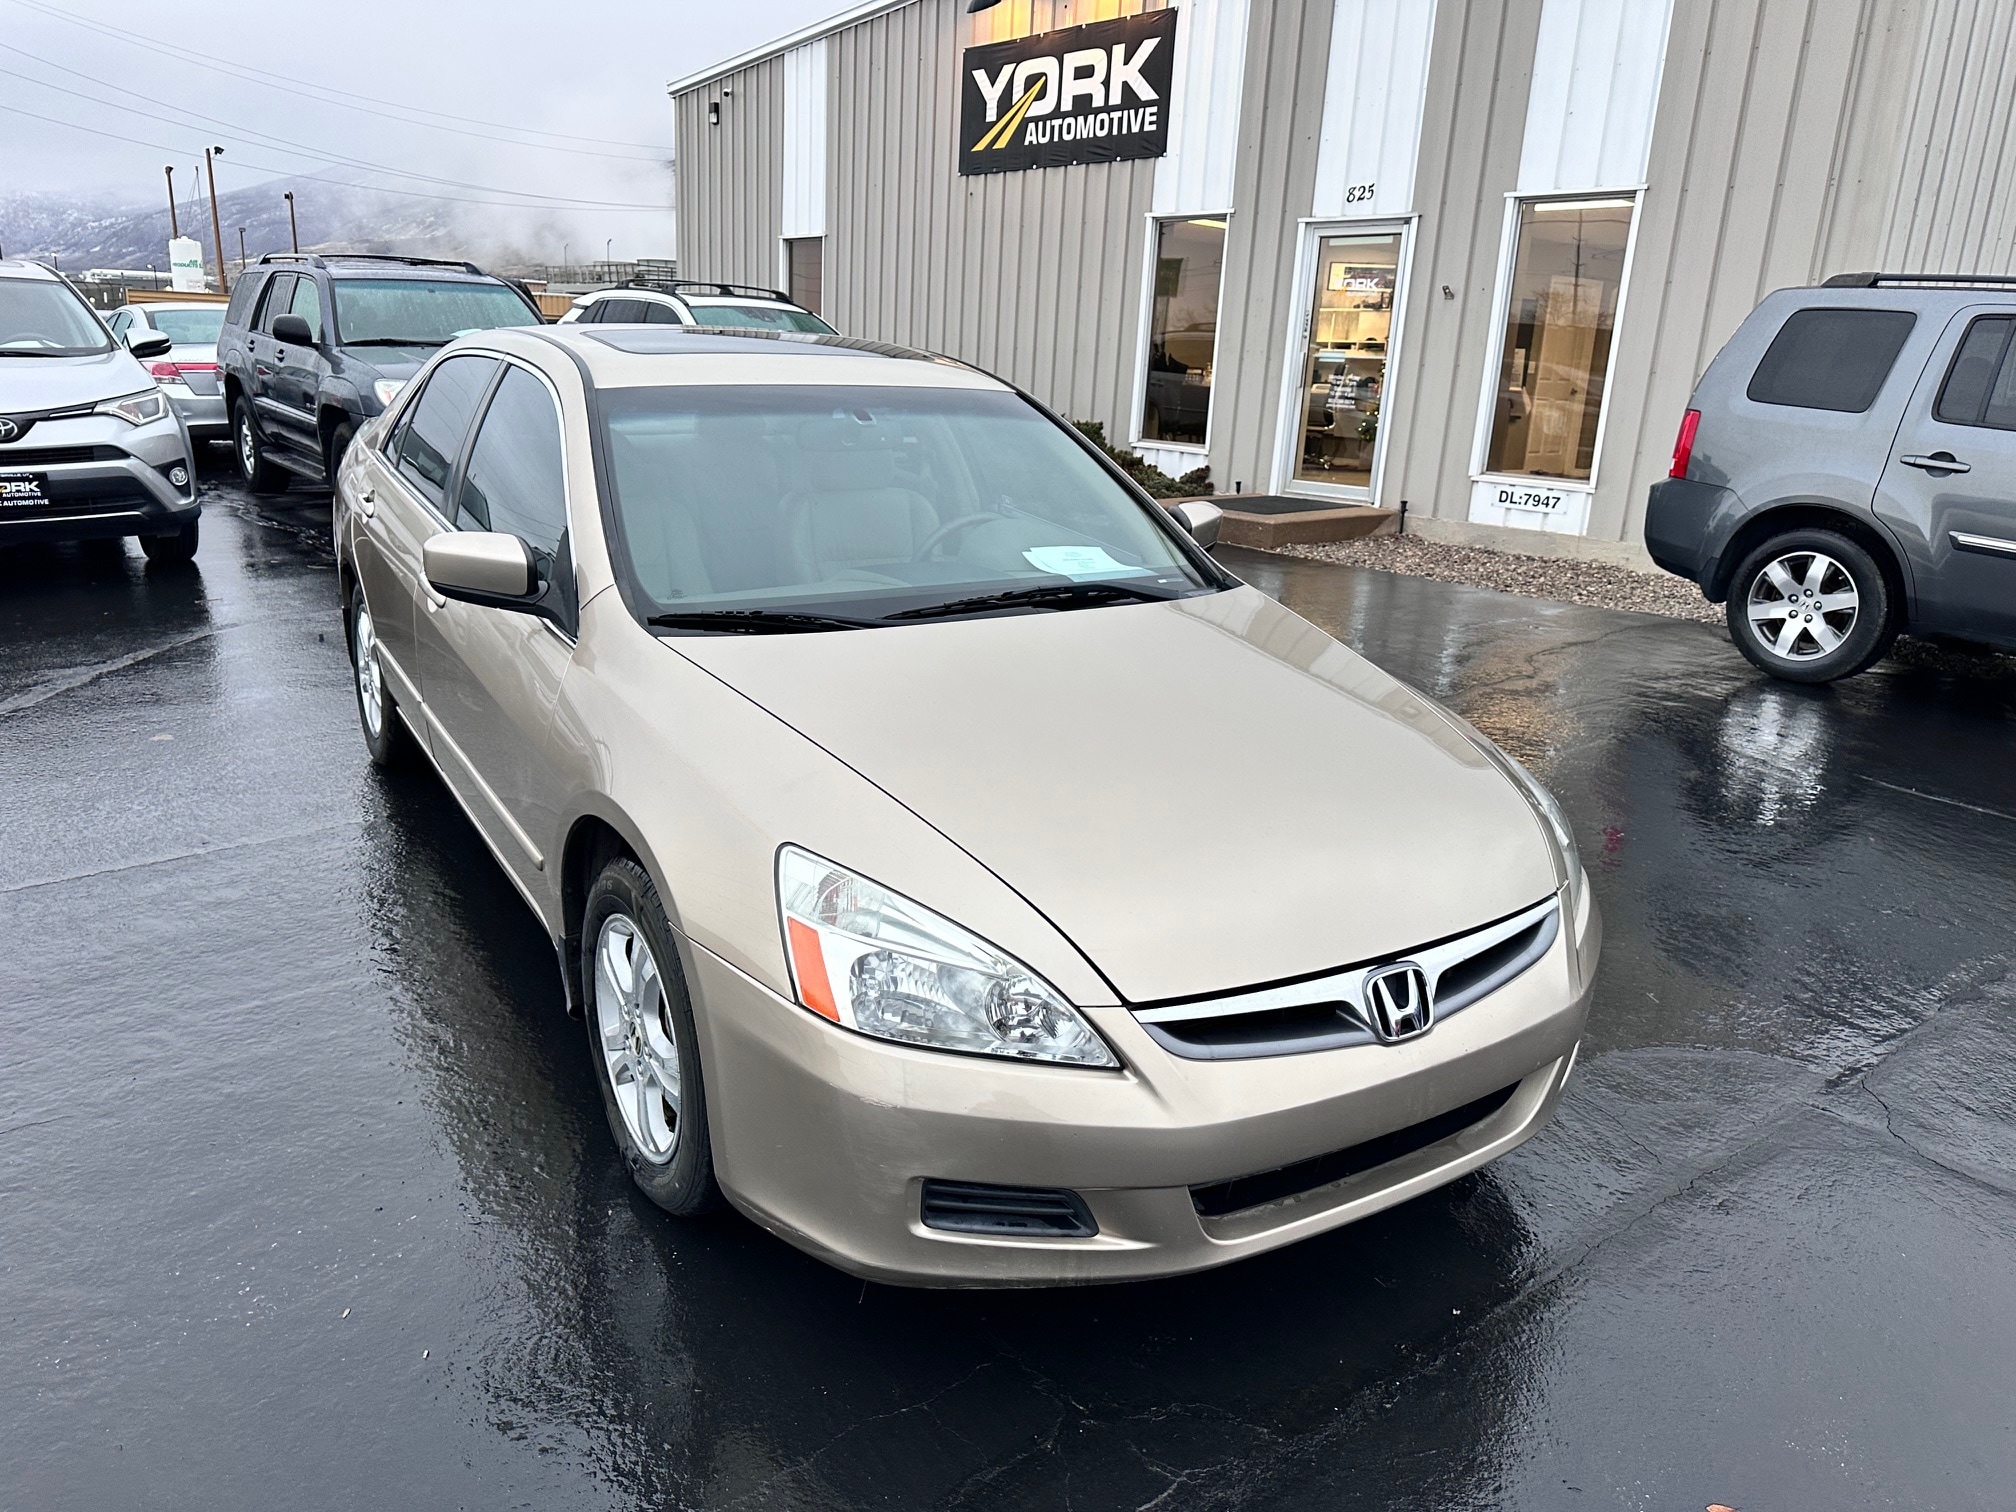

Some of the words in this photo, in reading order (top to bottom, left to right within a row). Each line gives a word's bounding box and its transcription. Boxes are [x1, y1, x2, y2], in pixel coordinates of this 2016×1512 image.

[971, 36, 1162, 123] YORK
[1023, 105, 1158, 146] AUTOMOTIVE
[1346, 182, 1376, 203] 825
[0, 481, 40, 493] ORK
[3, 498, 49, 506] AUTOMOTIVE
[1498, 490, 1561, 509] DL:7947
